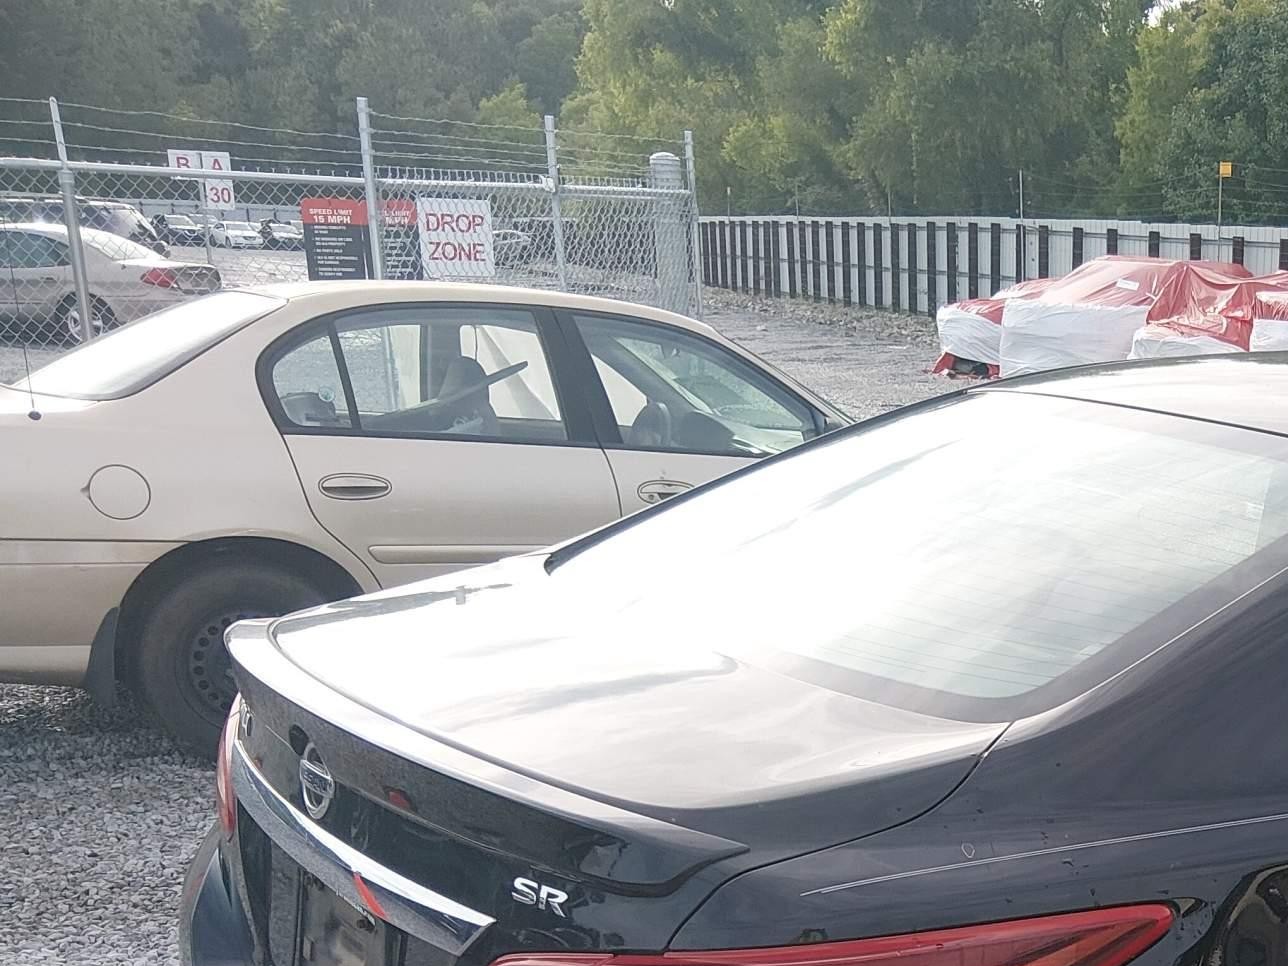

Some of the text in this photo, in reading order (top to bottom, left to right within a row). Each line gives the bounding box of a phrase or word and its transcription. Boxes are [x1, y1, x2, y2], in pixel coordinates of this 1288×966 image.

[209, 187, 231, 203] 30
[313, 215, 351, 224] 15 MPH
[425, 213, 485, 233] DROP
[428, 241, 487, 262] ZONE
[511, 876, 569, 918] SR
